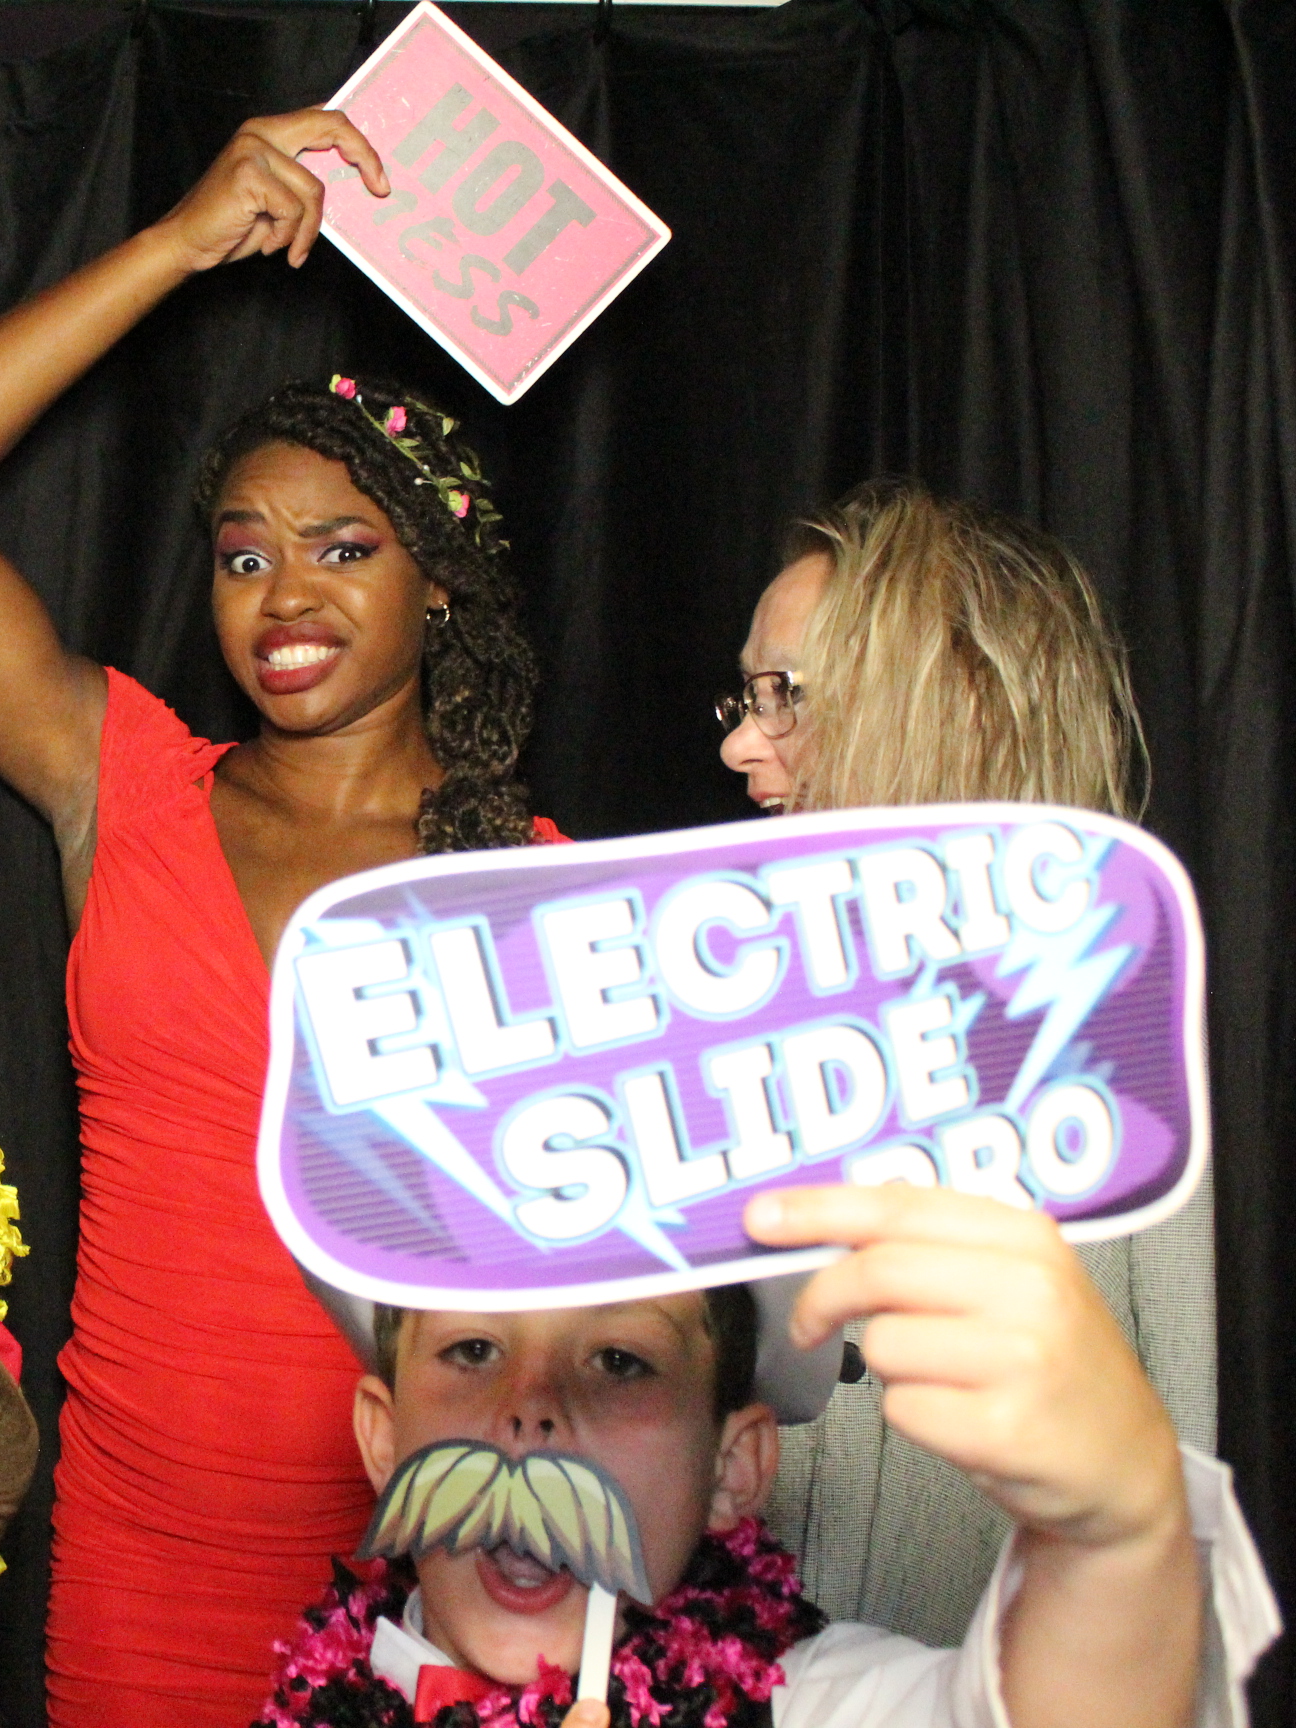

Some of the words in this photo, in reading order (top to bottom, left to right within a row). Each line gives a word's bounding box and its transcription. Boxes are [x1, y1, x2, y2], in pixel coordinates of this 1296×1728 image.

[391, 82, 597, 277] HOT
[298, 820, 1093, 1109] ELECTRIC
[501, 994, 973, 1242] SLIDE
